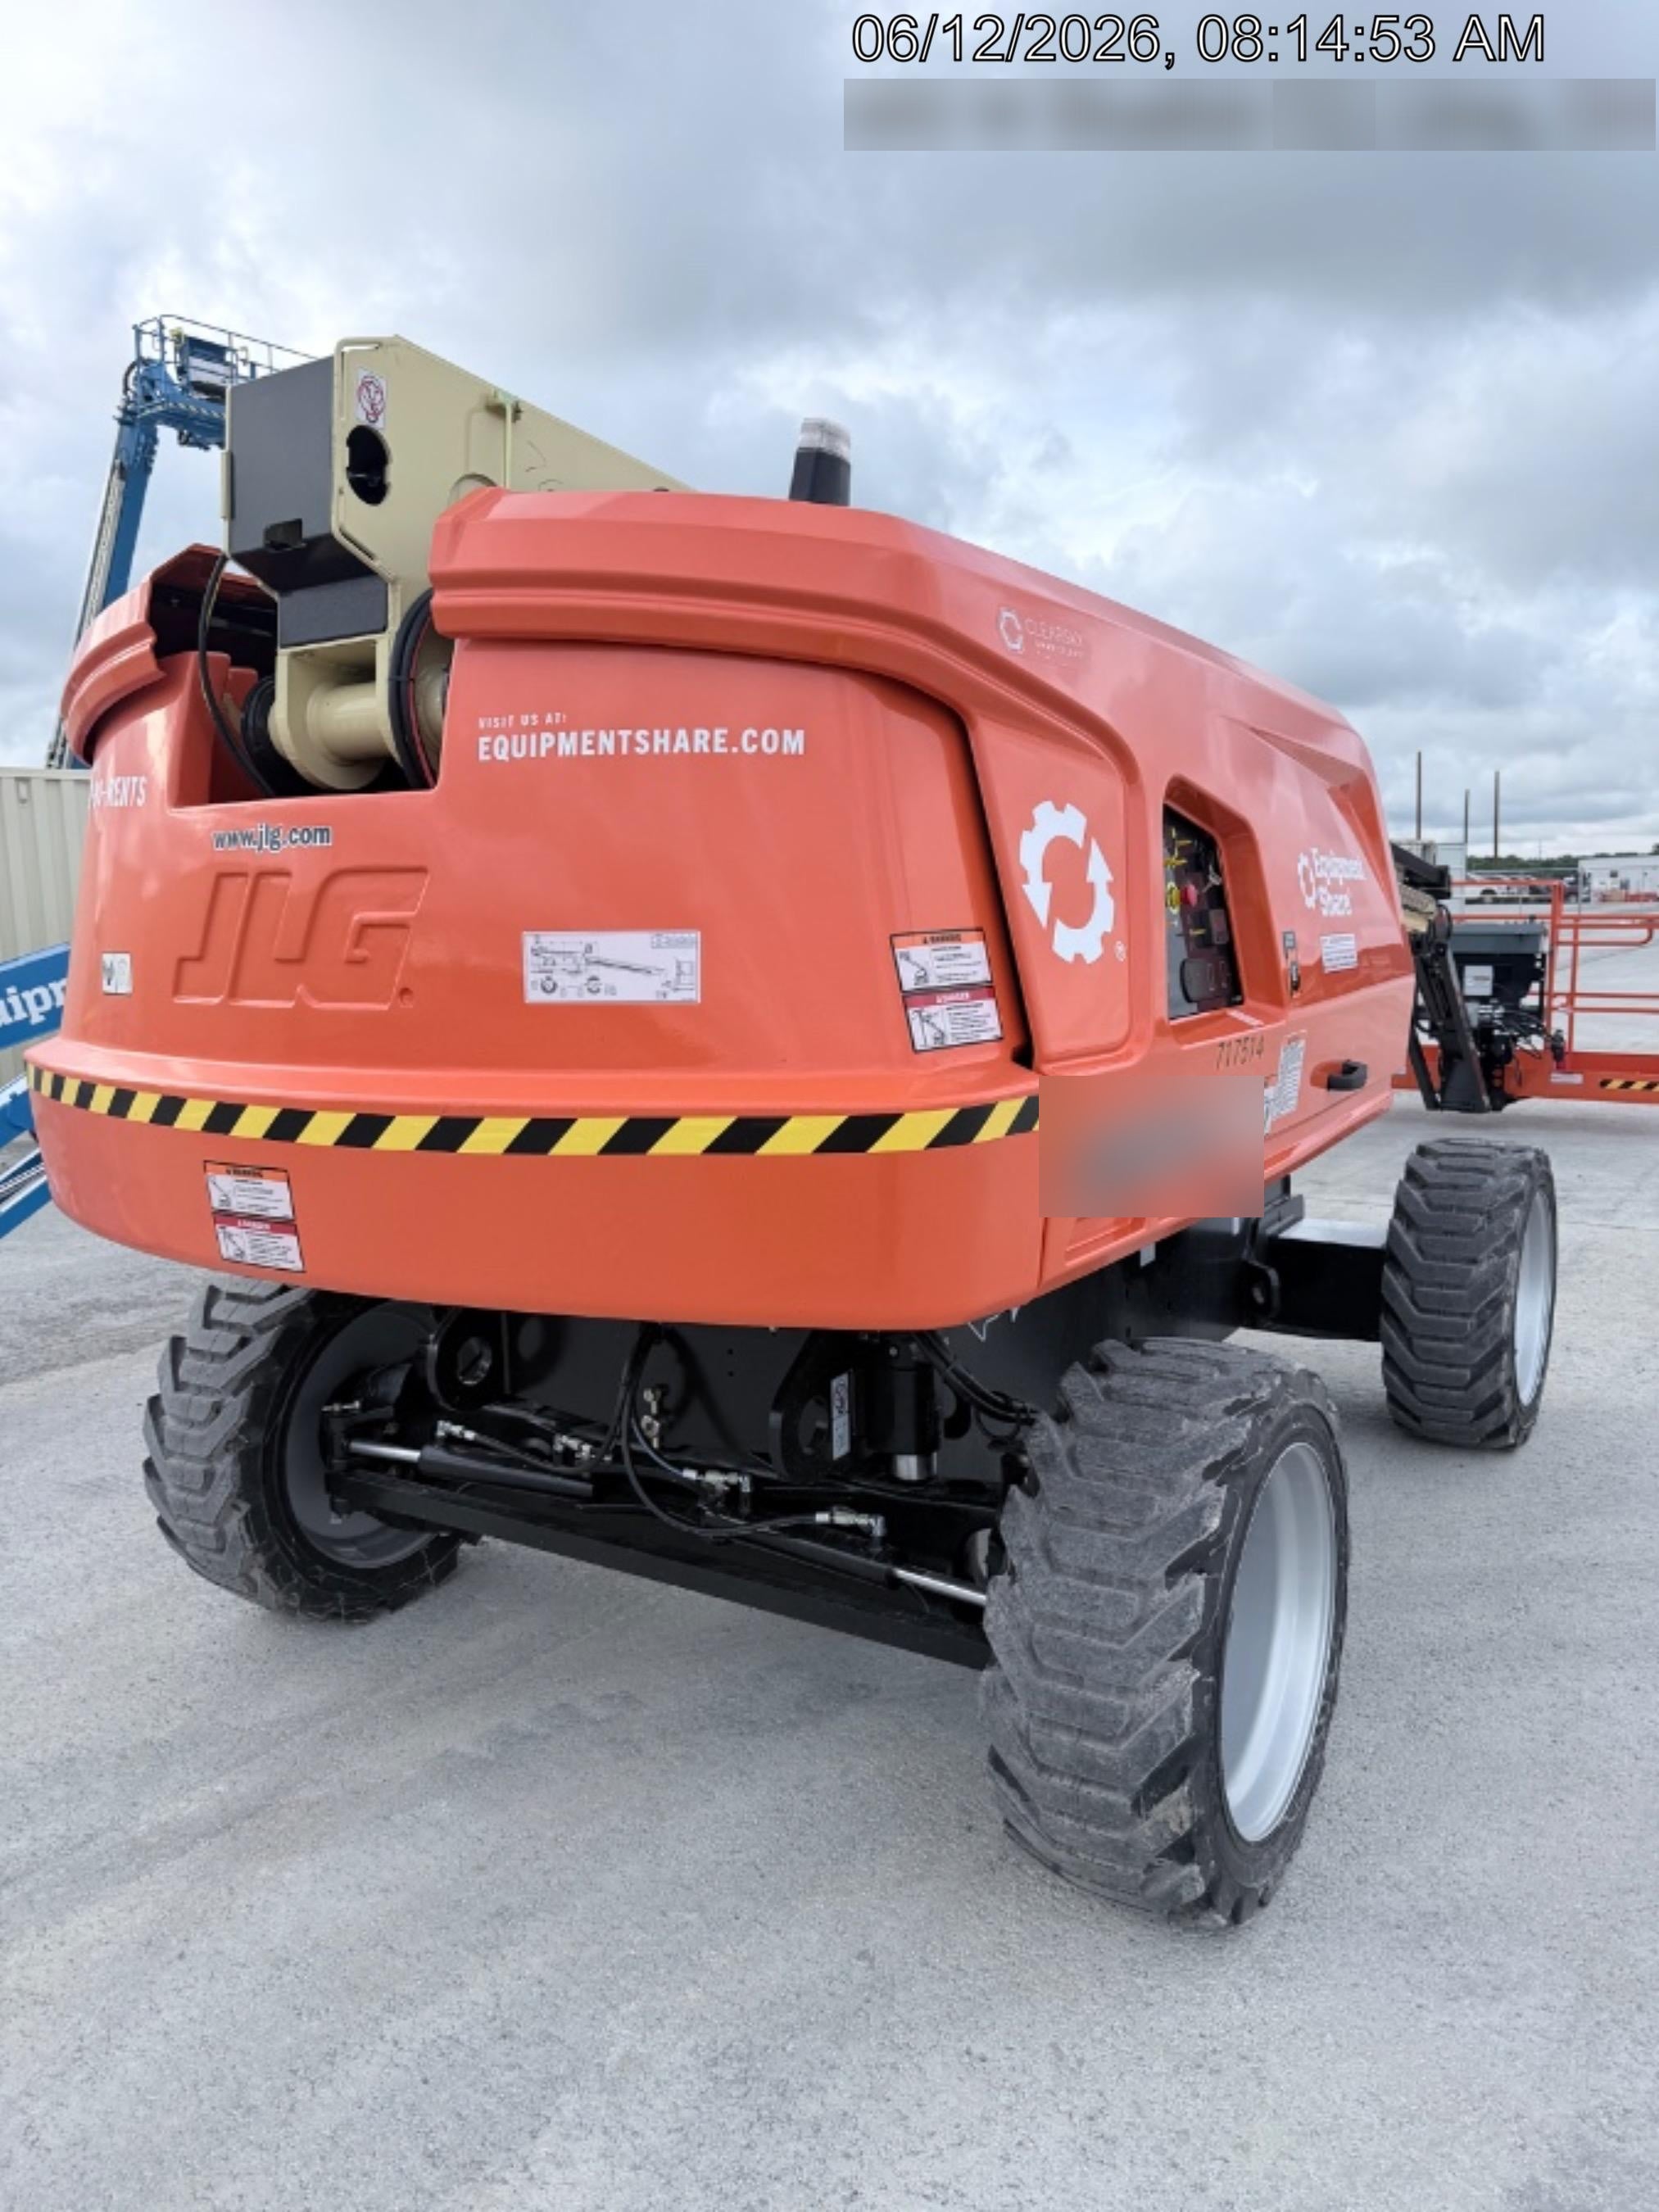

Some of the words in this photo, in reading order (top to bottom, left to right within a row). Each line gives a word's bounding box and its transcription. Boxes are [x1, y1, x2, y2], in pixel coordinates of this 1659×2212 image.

[478, 714, 514, 729] VISIT
[520, 713, 539, 727] US
[478, 728, 805, 762] EQUIPMENTSHARE.COM
[213, 823, 332, 851] www.jlg.com
[172, 864, 431, 1011] JLG
